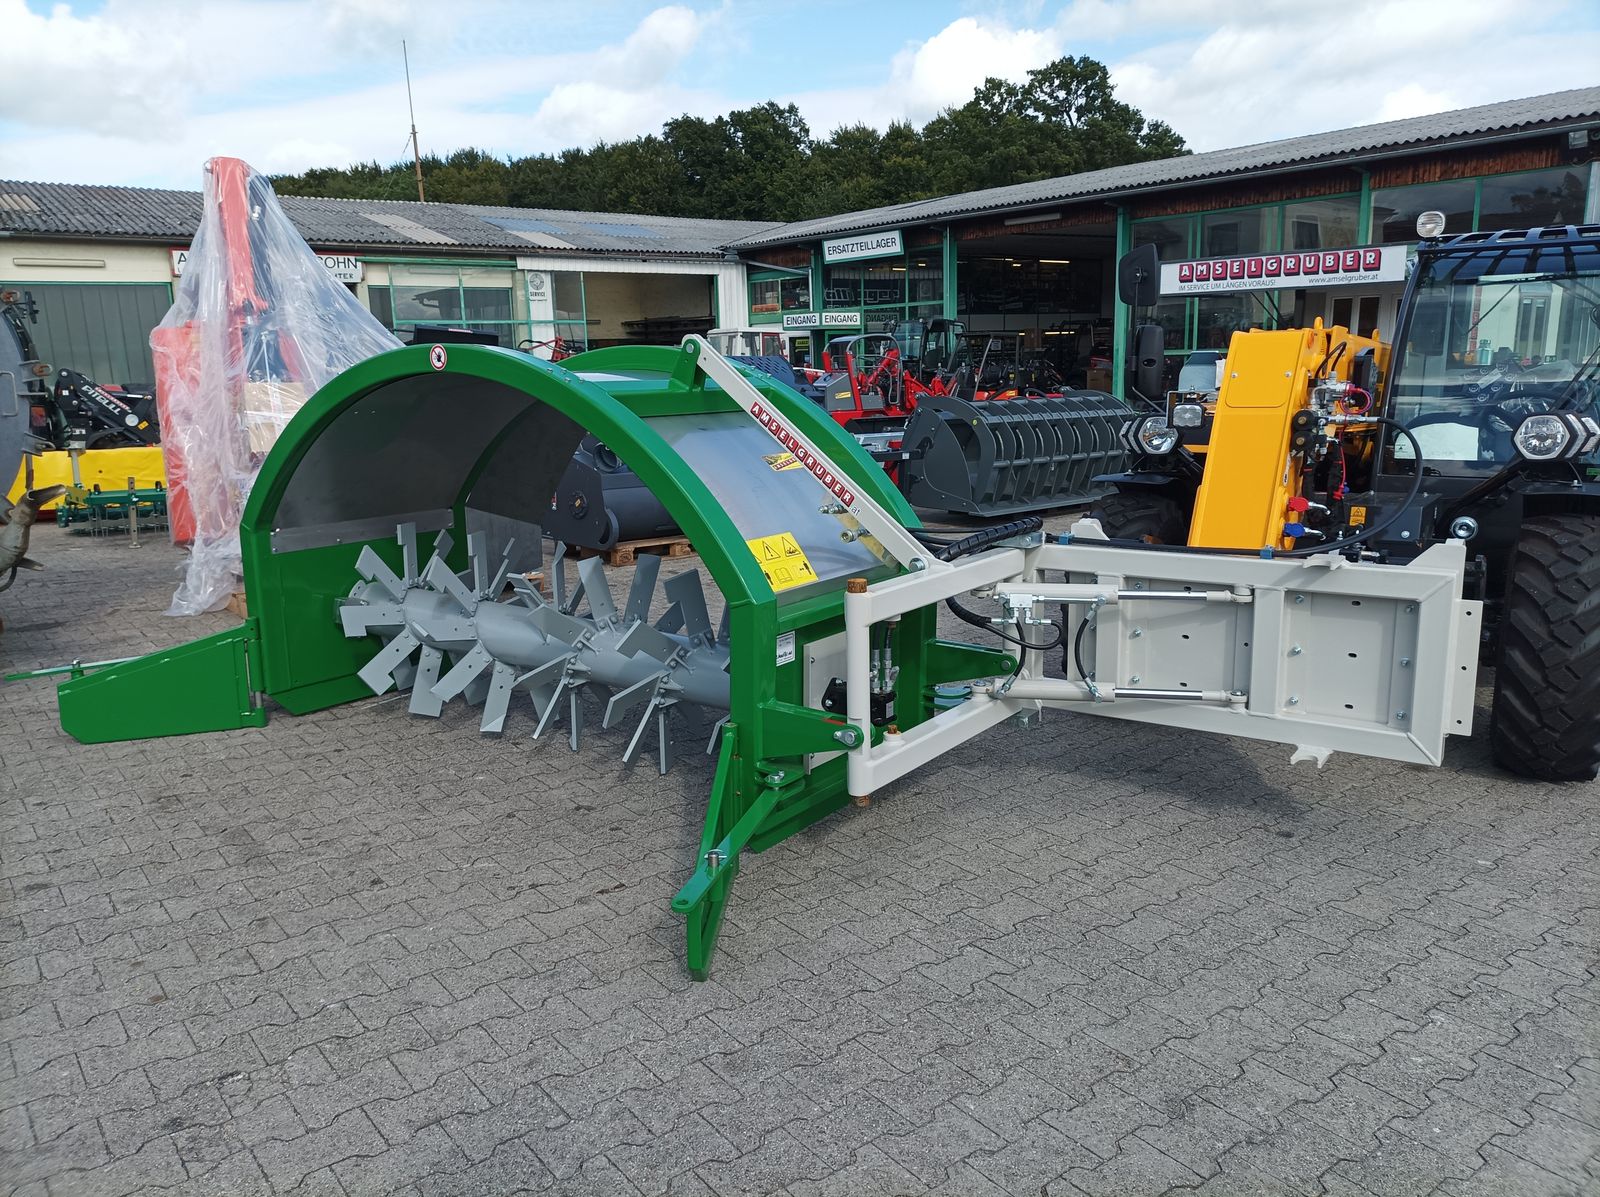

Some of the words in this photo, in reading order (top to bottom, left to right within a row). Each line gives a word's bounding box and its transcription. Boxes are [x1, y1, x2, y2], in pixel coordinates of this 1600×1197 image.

[827, 237, 897, 256] ERSATZTEILLAGER
[317, 256, 358, 269] OHN
[1180, 250, 1380, 281] AMSELGRUBER
[1187, 282, 1210, 291] SERVICE
[1211, 281, 1222, 289] UM
[1222, 279, 1247, 289] LÄNGEN
[1249, 279, 1276, 287] VORAUS!
[1308, 273, 1379, 284] www.amselgruber.at
[786, 315, 817, 326] EINGANG
[824, 314, 858, 324] EINGANG
[81, 384, 121, 415] PITBULL
